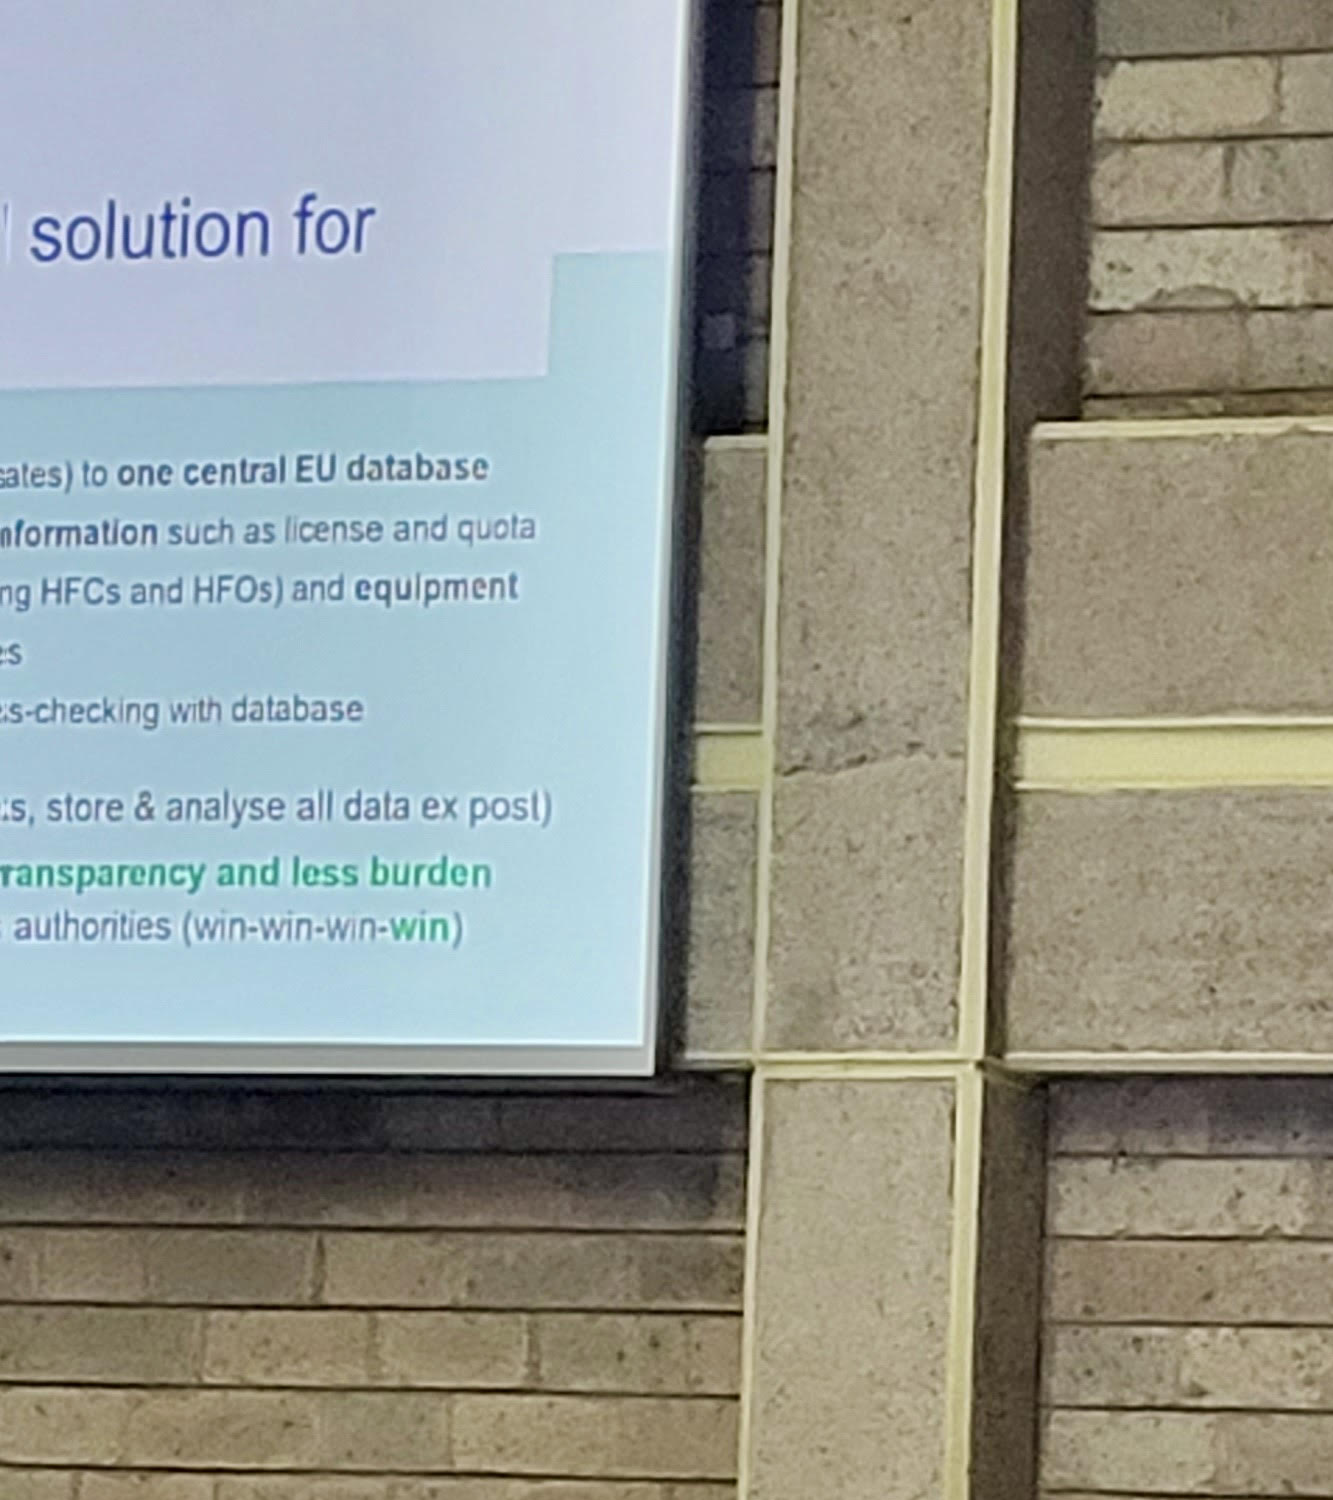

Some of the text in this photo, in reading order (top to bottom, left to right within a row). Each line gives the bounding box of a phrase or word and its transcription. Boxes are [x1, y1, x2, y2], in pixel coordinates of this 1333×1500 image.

[30, 197, 270, 262] solution
[293, 192, 376, 255] for
[82, 460, 108, 487] to
[117, 464, 173, 486] one
[183, 455, 286, 485] central
[296, 454, 337, 482] EU
[346, 453, 489, 481] database
[168, 517, 234, 545] such
[243, 522, 275, 544] as
[284, 515, 384, 544] license
[393, 513, 448, 543] and
[457, 512, 536, 548] quota
[40, 577, 121, 605] HFCs
[130, 576, 183, 604] and
[194, 574, 284, 609] HFOs)
[292, 574, 345, 602] and
[355, 571, 519, 609] equipment
[169, 697, 222, 724] with
[231, 694, 365, 723] database
[47, 792, 124, 822] store
[134, 790, 155, 821] &
[166, 788, 286, 830] analyse
[296, 788, 333, 821] all
[343, 789, 410, 821] data
[421, 796, 458, 821] ex
[469, 789, 553, 829] post)
[217, 856, 280, 887] and
[292, 855, 359, 887] less
[370, 855, 492, 888] burden
[14, 908, 463, 949] authorities (win-win-win-win)
